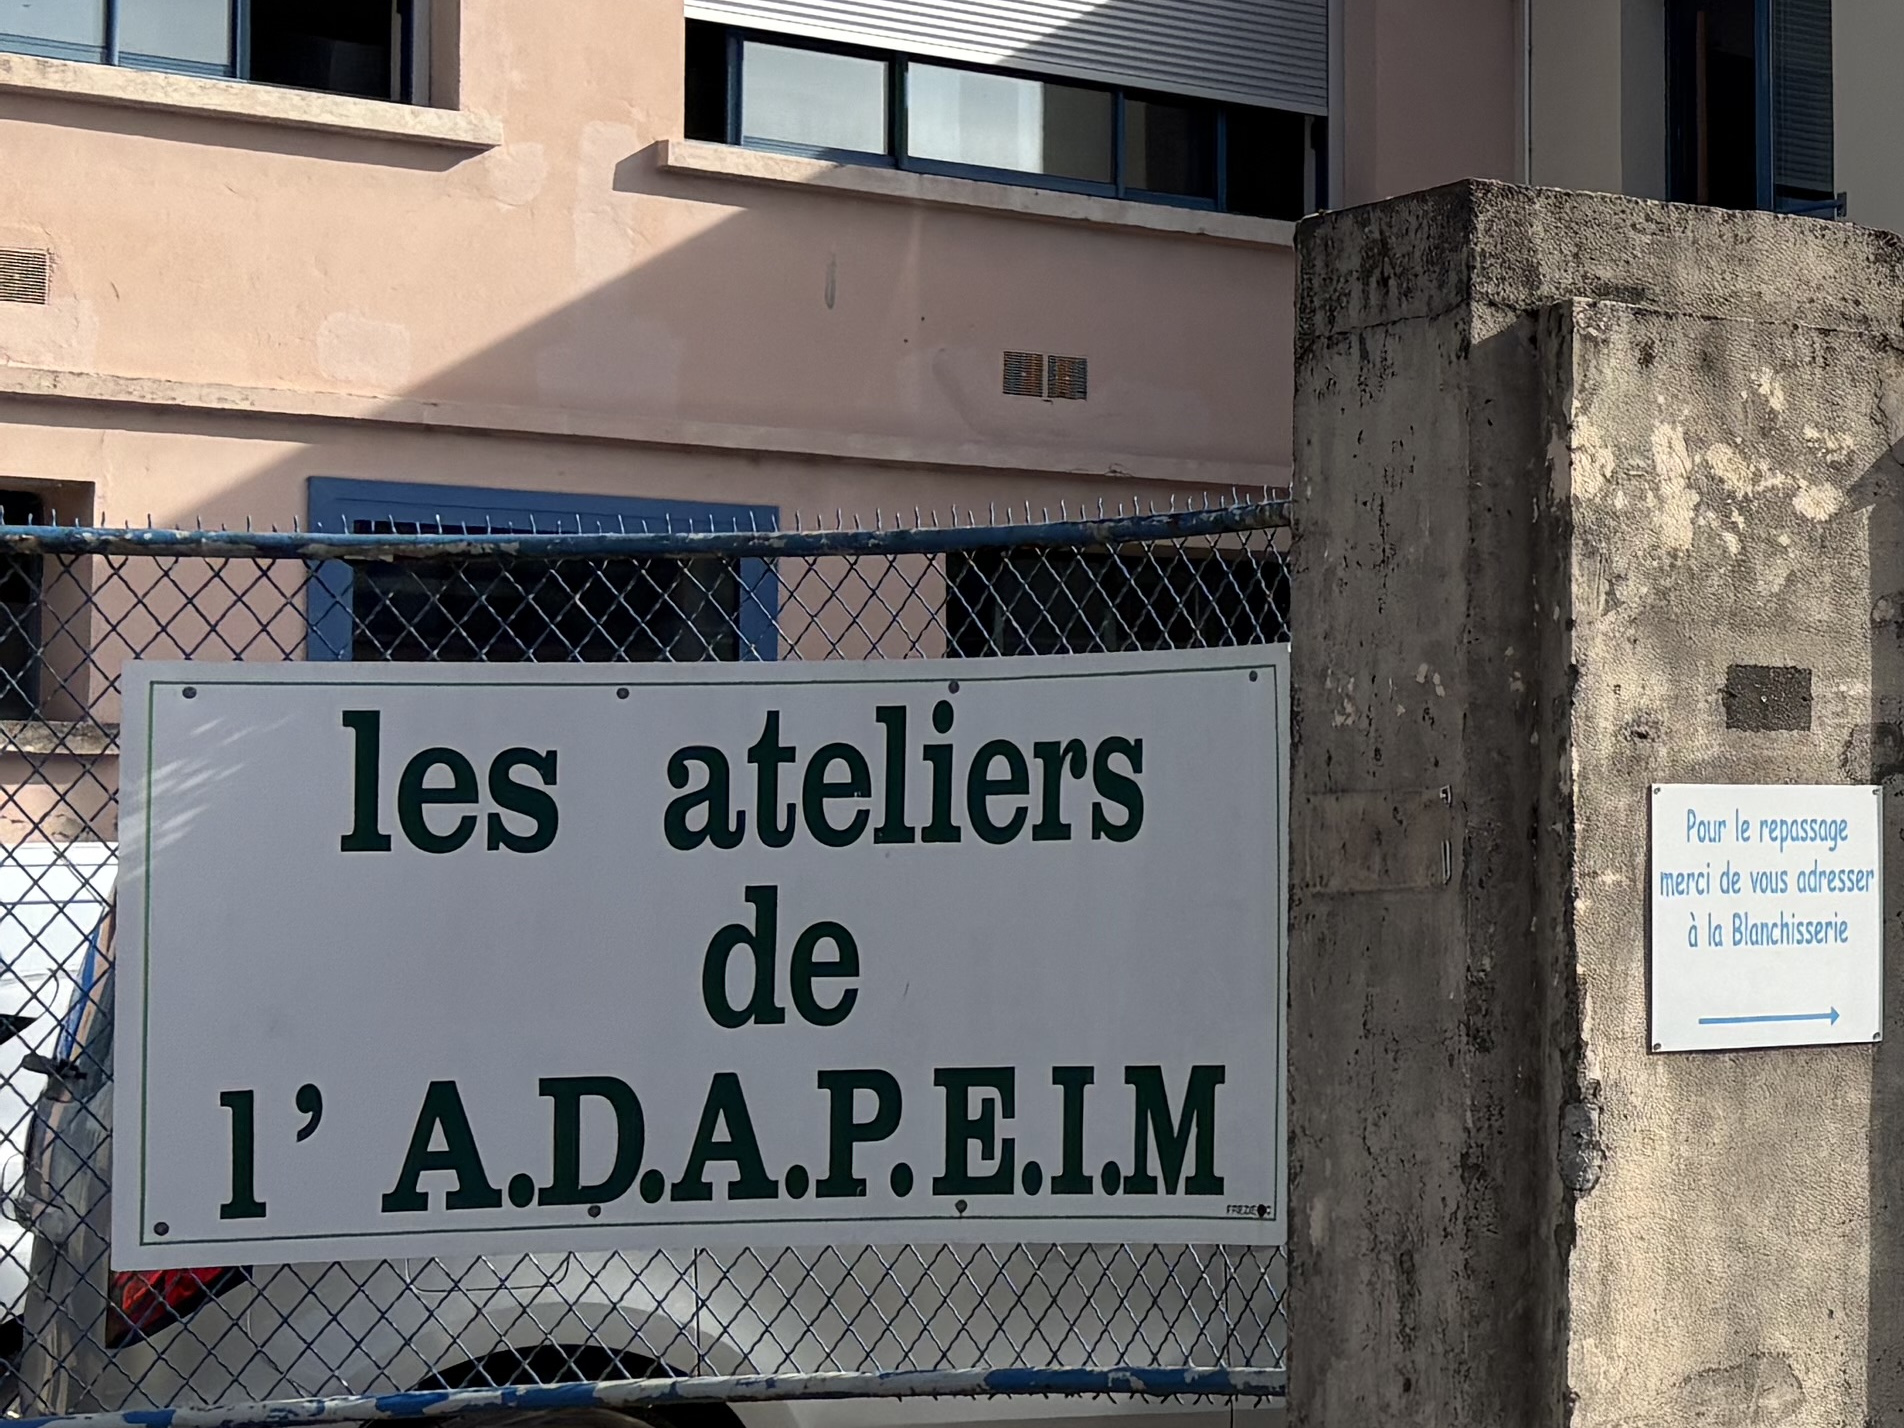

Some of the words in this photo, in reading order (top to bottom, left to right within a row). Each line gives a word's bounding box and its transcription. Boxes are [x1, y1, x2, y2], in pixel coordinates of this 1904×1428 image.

[341, 710, 558, 854] les
[664, 699, 1144, 851] ateliers
[1687, 808, 1726, 843] Pour
[1736, 808, 1750, 842] le
[1760, 818, 1848, 853] repassage
[1660, 862, 1710, 897] merci
[1720, 860, 1741, 895] de
[1750, 870, 1788, 894] vous
[1797, 859, 1874, 893] adresser
[702, 885, 859, 1029] de
[1688, 911, 1698, 948] à
[1708, 912, 1723, 947] la
[1732, 910, 1848, 947] Blanchisserie
[381, 1065, 1226, 1213] A.D.A.P.E.I.M
